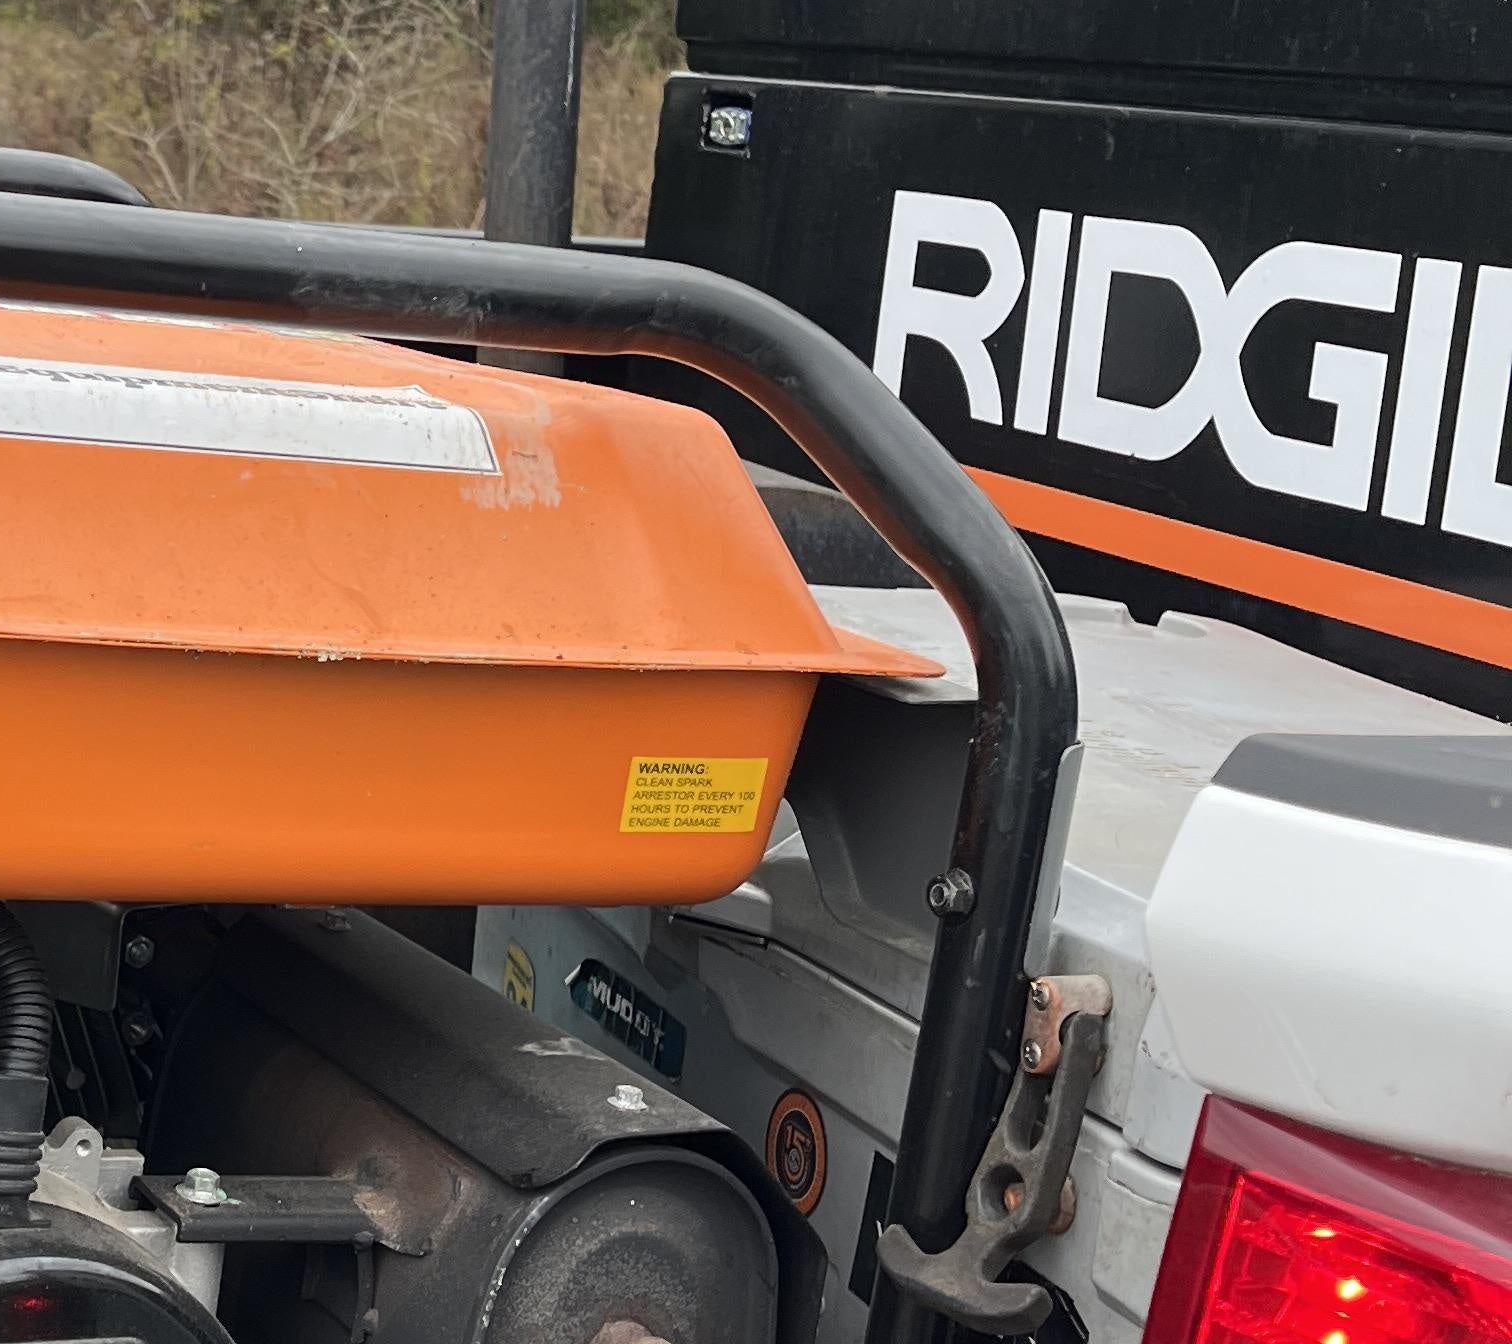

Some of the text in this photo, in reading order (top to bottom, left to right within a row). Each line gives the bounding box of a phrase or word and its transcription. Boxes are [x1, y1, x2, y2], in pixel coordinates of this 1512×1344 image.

[639, 763, 710, 775] WARNING:
[636, 777, 713, 787] CLEAN SPARK
[632, 791, 756, 801] ARRESTOR EVERY 100
[631, 804, 744, 814] HOURS TO PREVENT
[628, 817, 721, 827] ENGINE DAMAGE
